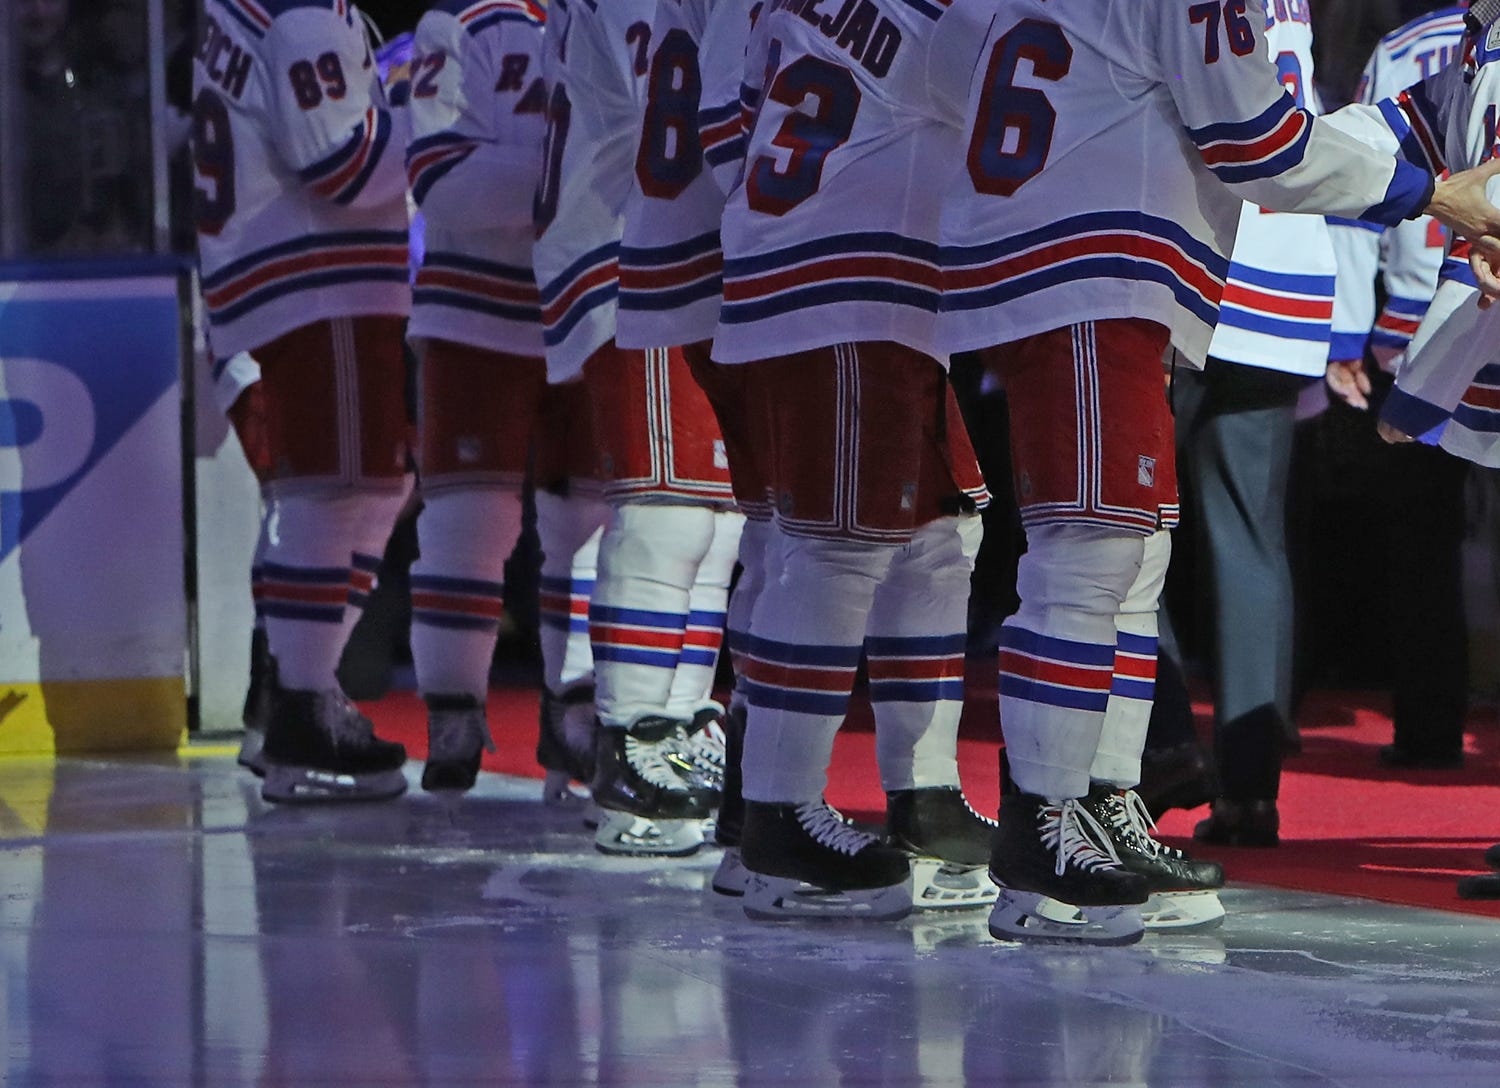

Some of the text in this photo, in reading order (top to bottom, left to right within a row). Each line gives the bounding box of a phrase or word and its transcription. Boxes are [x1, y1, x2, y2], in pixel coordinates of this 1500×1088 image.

[289, 52, 347, 110] 89
[746, 39, 861, 217] 3
[967, 13, 1073, 198] 6
